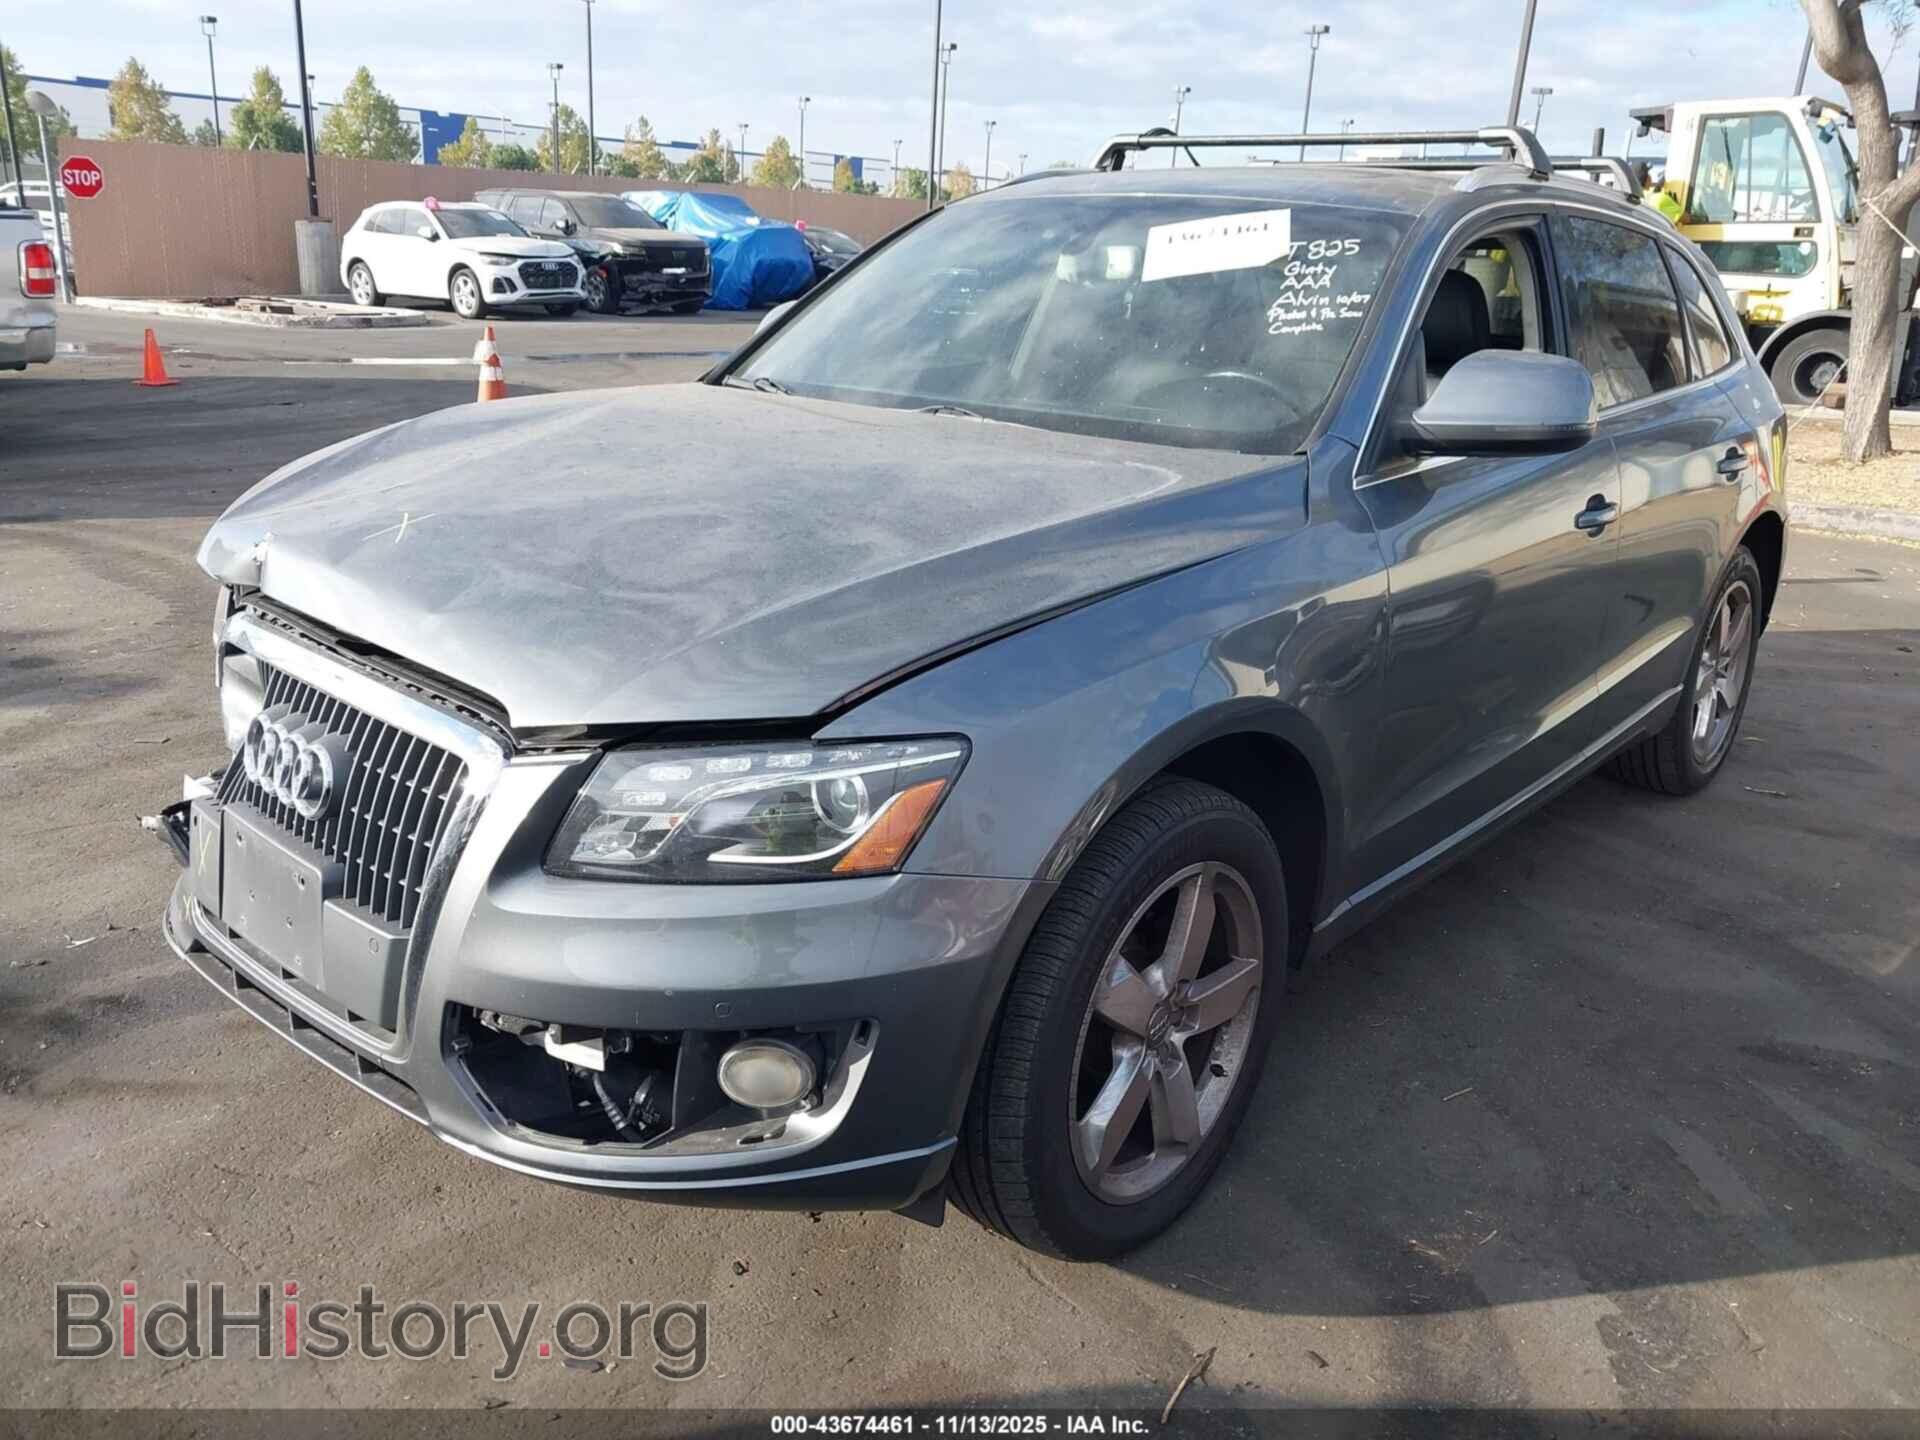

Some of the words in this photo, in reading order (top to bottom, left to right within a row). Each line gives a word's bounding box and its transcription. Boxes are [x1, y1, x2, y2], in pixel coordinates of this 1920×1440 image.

[63, 169, 101, 186] STOP
[1280, 274, 1331, 290] AAA
[1271, 290, 1330, 308] Alvin
